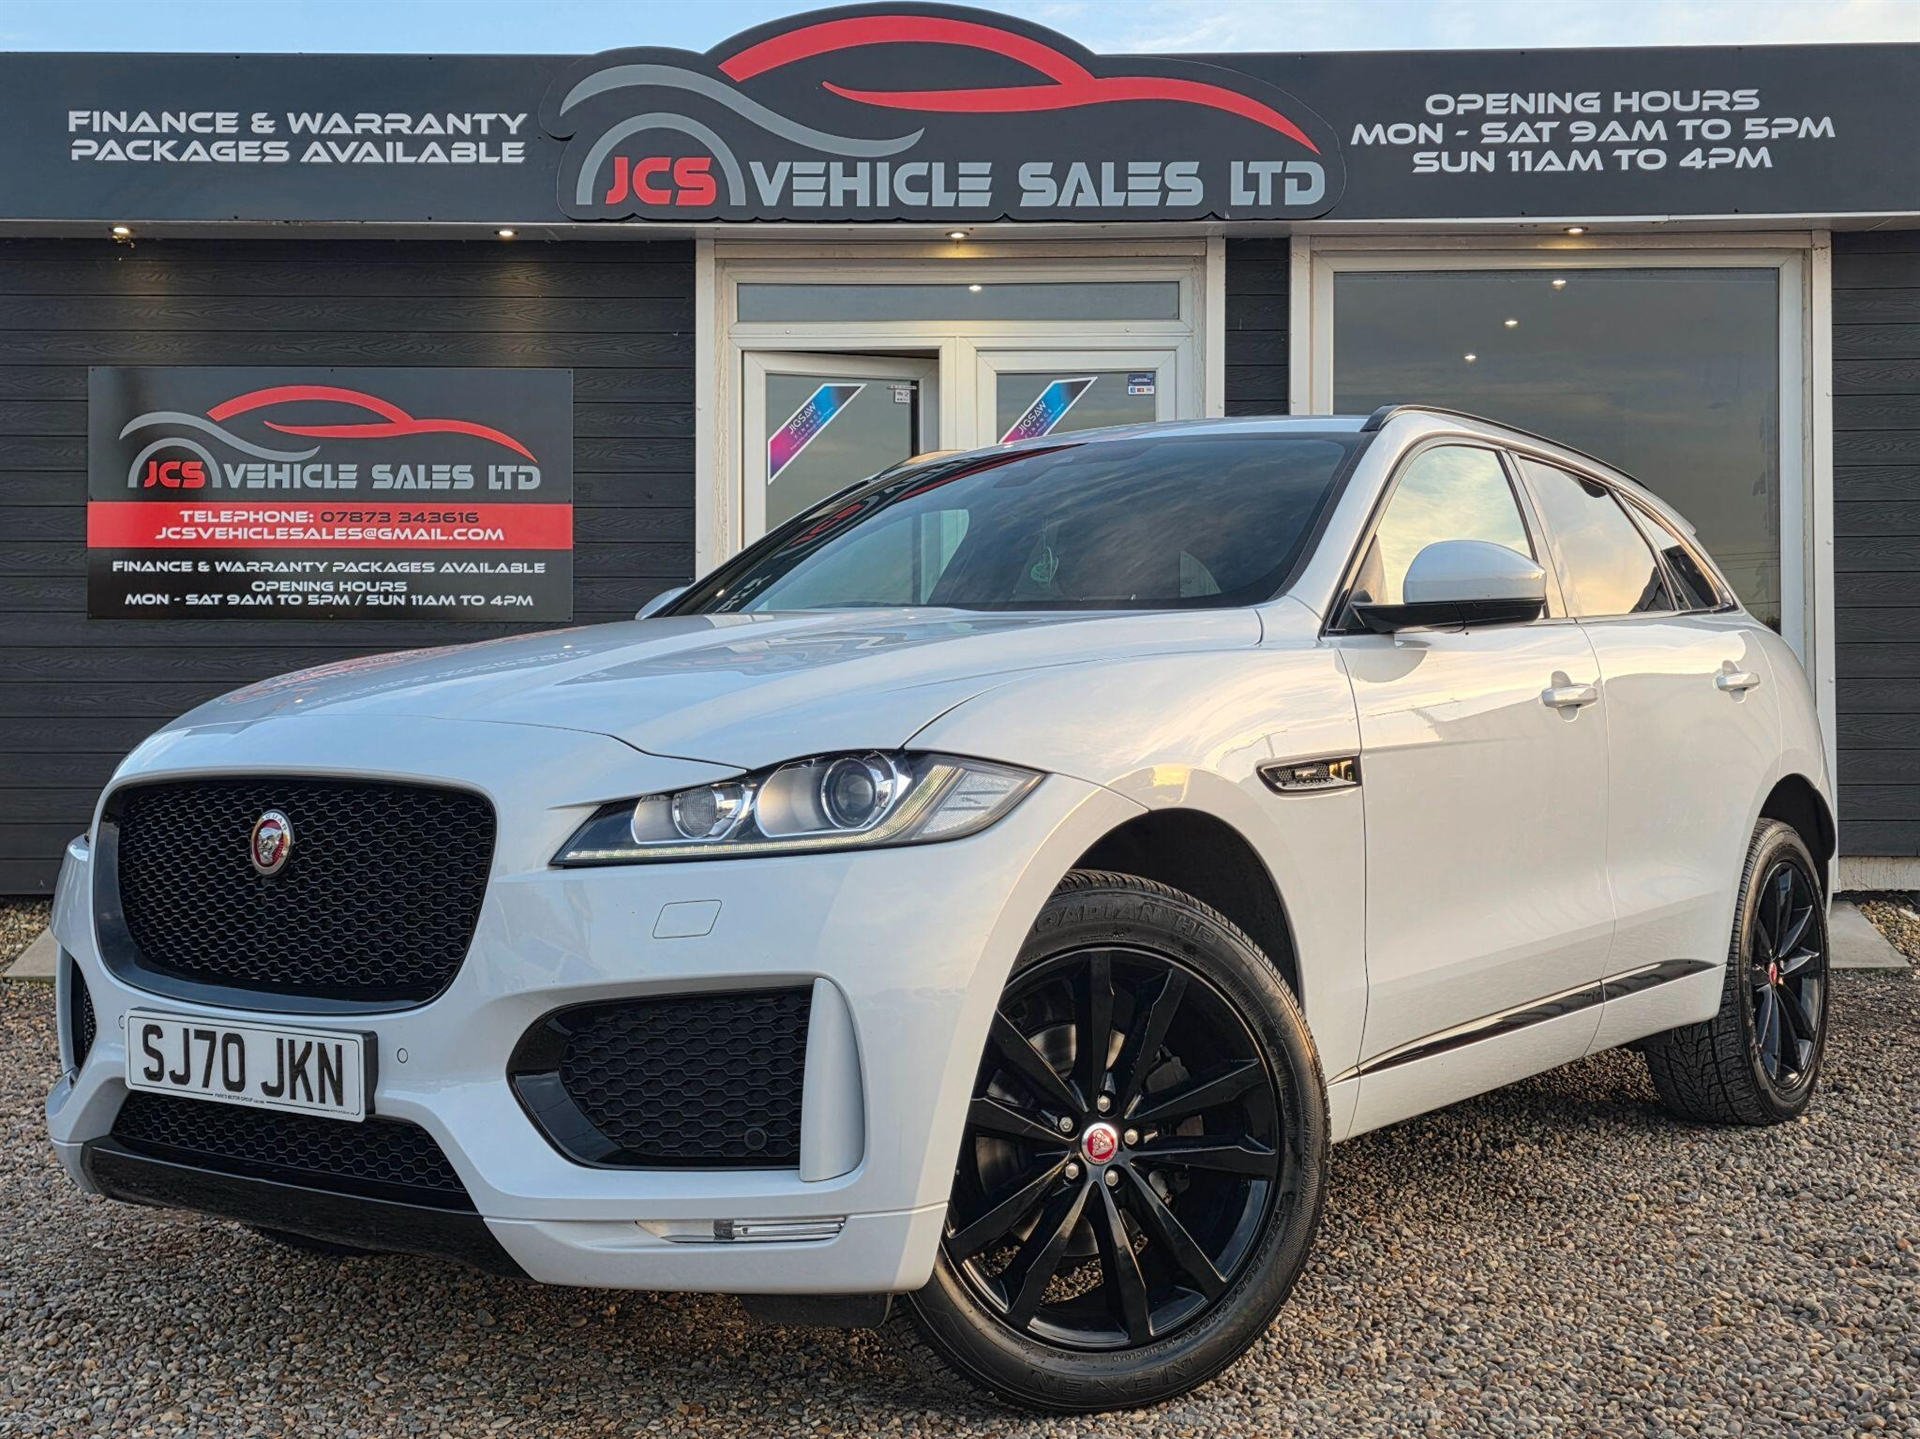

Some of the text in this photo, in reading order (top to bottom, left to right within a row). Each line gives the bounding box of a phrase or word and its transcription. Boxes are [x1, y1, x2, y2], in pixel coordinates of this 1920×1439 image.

[1425, 88, 1760, 116] OPENING HOURS
[68, 110, 528, 135] FINANCE & WARRANTY
[1350, 123, 1445, 146] MON
[1480, 120, 1561, 144] SAT
[1569, 119, 1669, 143] 9AM
[1677, 118, 1739, 141] TO
[1744, 115, 1837, 140] 5PM
[71, 139, 526, 164] PACKAGES AVAILABLE
[1412, 146, 1774, 174] SUN 11AM TO 4PM
[605, 156, 1326, 207] JCS VEHICLE SALES LTD
[788, 401, 817, 435] JIGSAW
[1018, 400, 1047, 435] JIGSAW
[143, 460, 541, 490] JCS VEHICLE SALES LTD
[179, 510, 480, 524] TELEPHONE: 07873 343616
[155, 526, 505, 541] JCSVEHICLESALES@GMAIL.COM
[112, 560, 546, 574] FINANCE & WARRANTY PACKAGES AVAILABLE
[125, 593, 169, 605] MON
[185, 594, 224, 606] SAT
[227, 594, 273, 606] 9AM
[277, 594, 303, 606] TO
[307, 594, 350, 606] 5PM
[354, 594, 362, 606] /
[366, 594, 405, 606] SUN
[410, 594, 456, 606] 11AM
[460, 594, 486, 606] TO
[490, 594, 534, 607] 4PM
[251, 580, 408, 593] OPENING HOURS
[142, 1023, 344, 1107] SJ70 JKN
